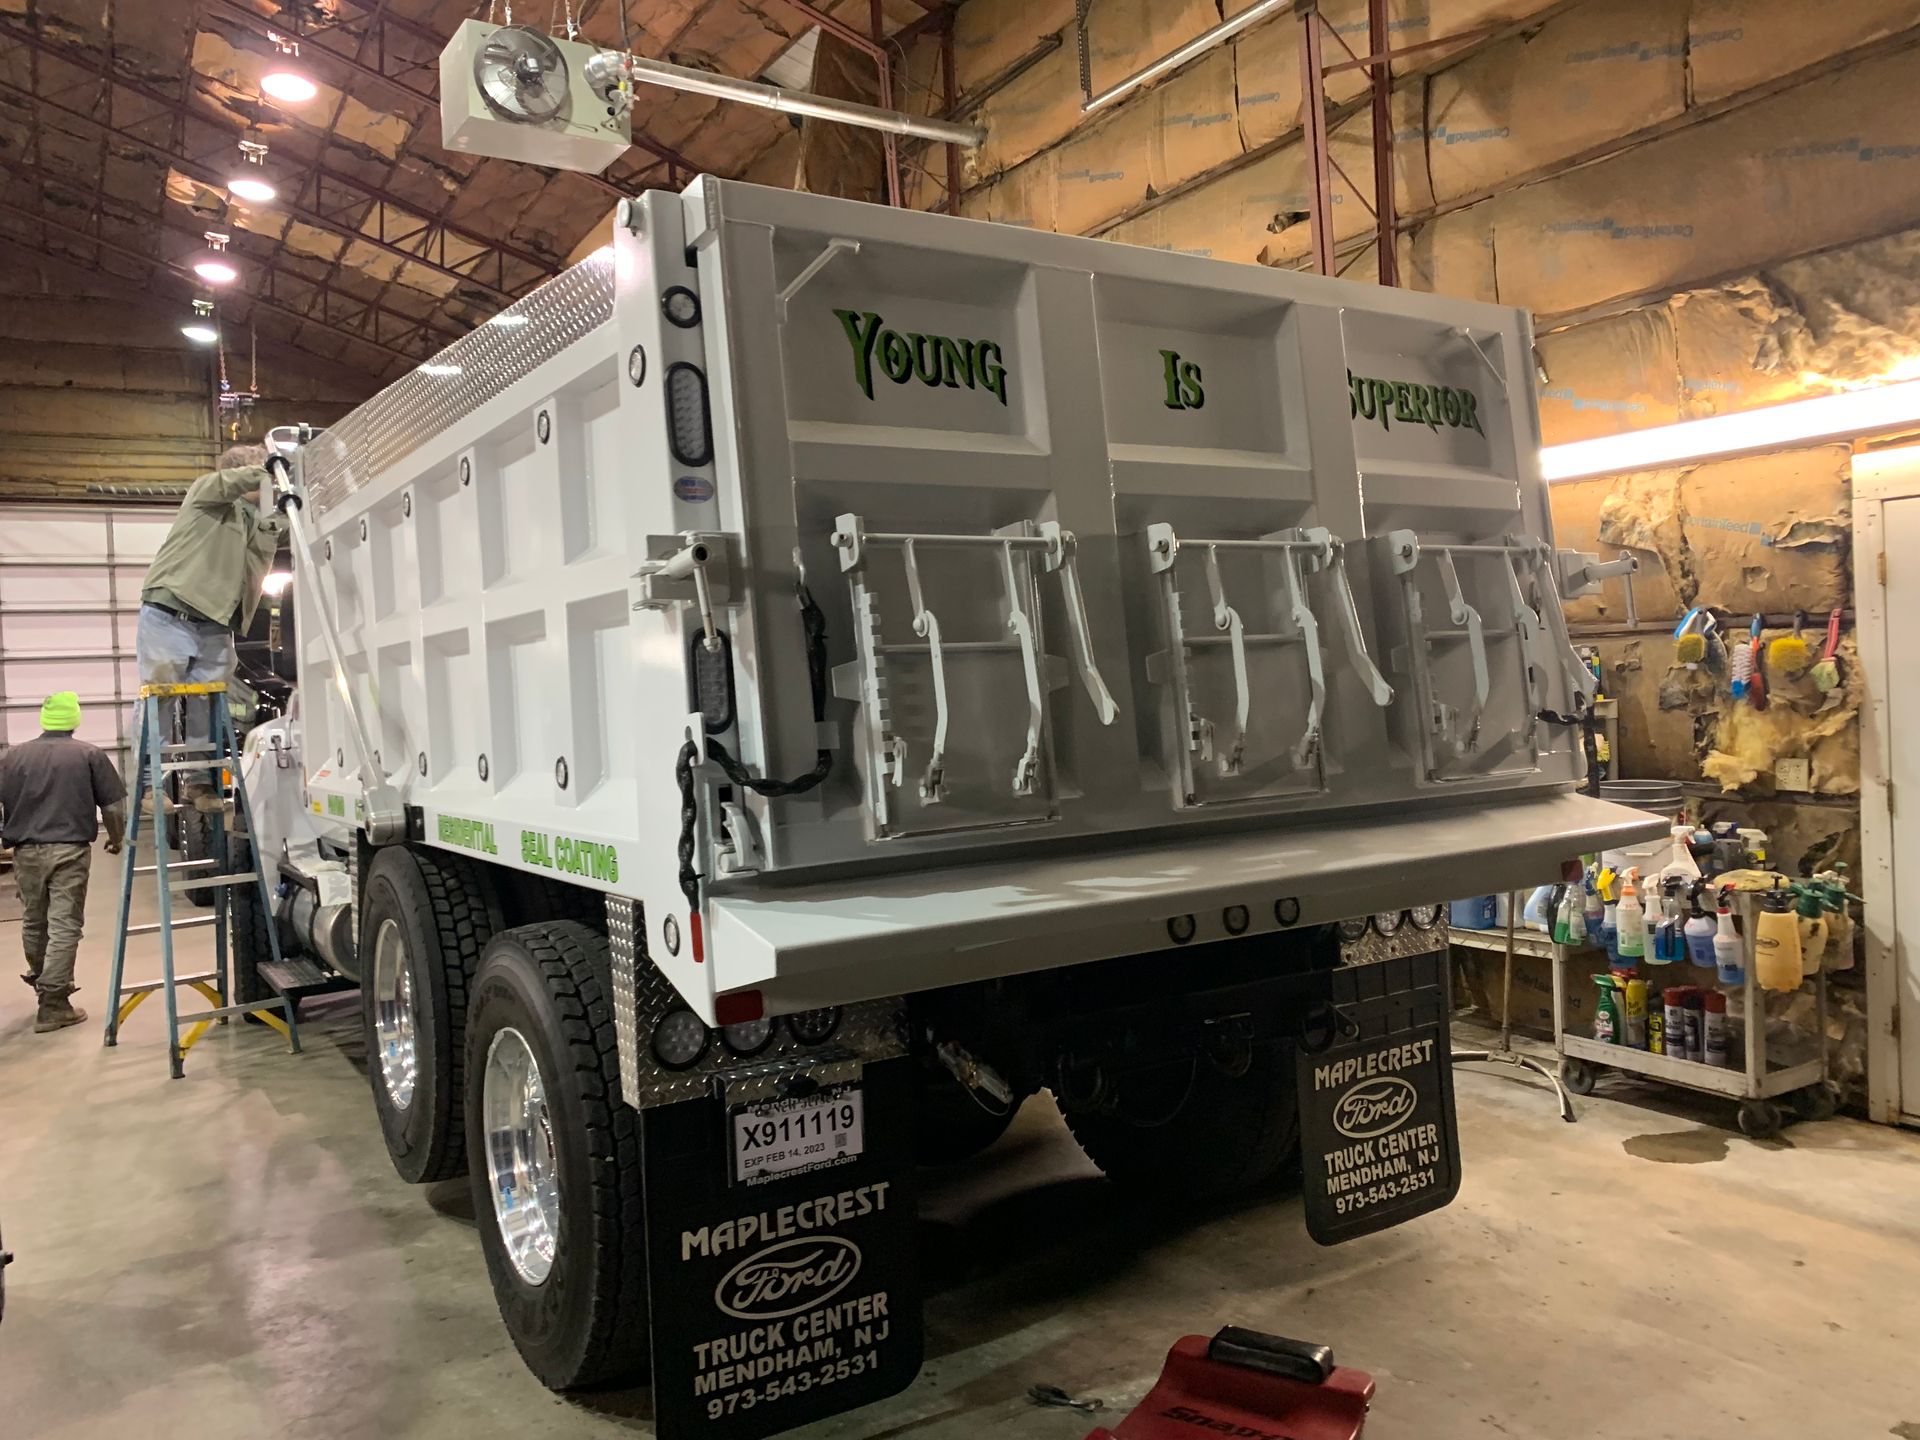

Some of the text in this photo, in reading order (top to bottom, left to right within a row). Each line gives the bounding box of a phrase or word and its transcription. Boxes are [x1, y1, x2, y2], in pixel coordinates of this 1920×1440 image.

[520, 830, 553, 868] SEAL
[554, 836, 620, 884] COATING
[1314, 1039, 1434, 1091] MAPLECREST
[742, 1104, 855, 1151] X911119
[1342, 1086, 1411, 1130] Ford
[744, 1156, 764, 1168] EXP
[766, 1151, 786, 1163] FEB
[804, 1143, 825, 1155] 2023
[746, 1155, 858, 1187] MaplecrestFord.com
[1324, 1123, 1438, 1175] TRUCK CENTER
[1326, 1156, 1412, 1195] MENDHAM,
[1335, 1168, 1435, 1215] 973-543-2531
[681, 1181, 890, 1261] MAPLECREST
[731, 1247, 851, 1310] Ford
[693, 1291, 889, 1371] TRUCK CENTER
[694, 1337, 842, 1397] MENDHAM,
[707, 1350, 878, 1420] 973-543-2531
